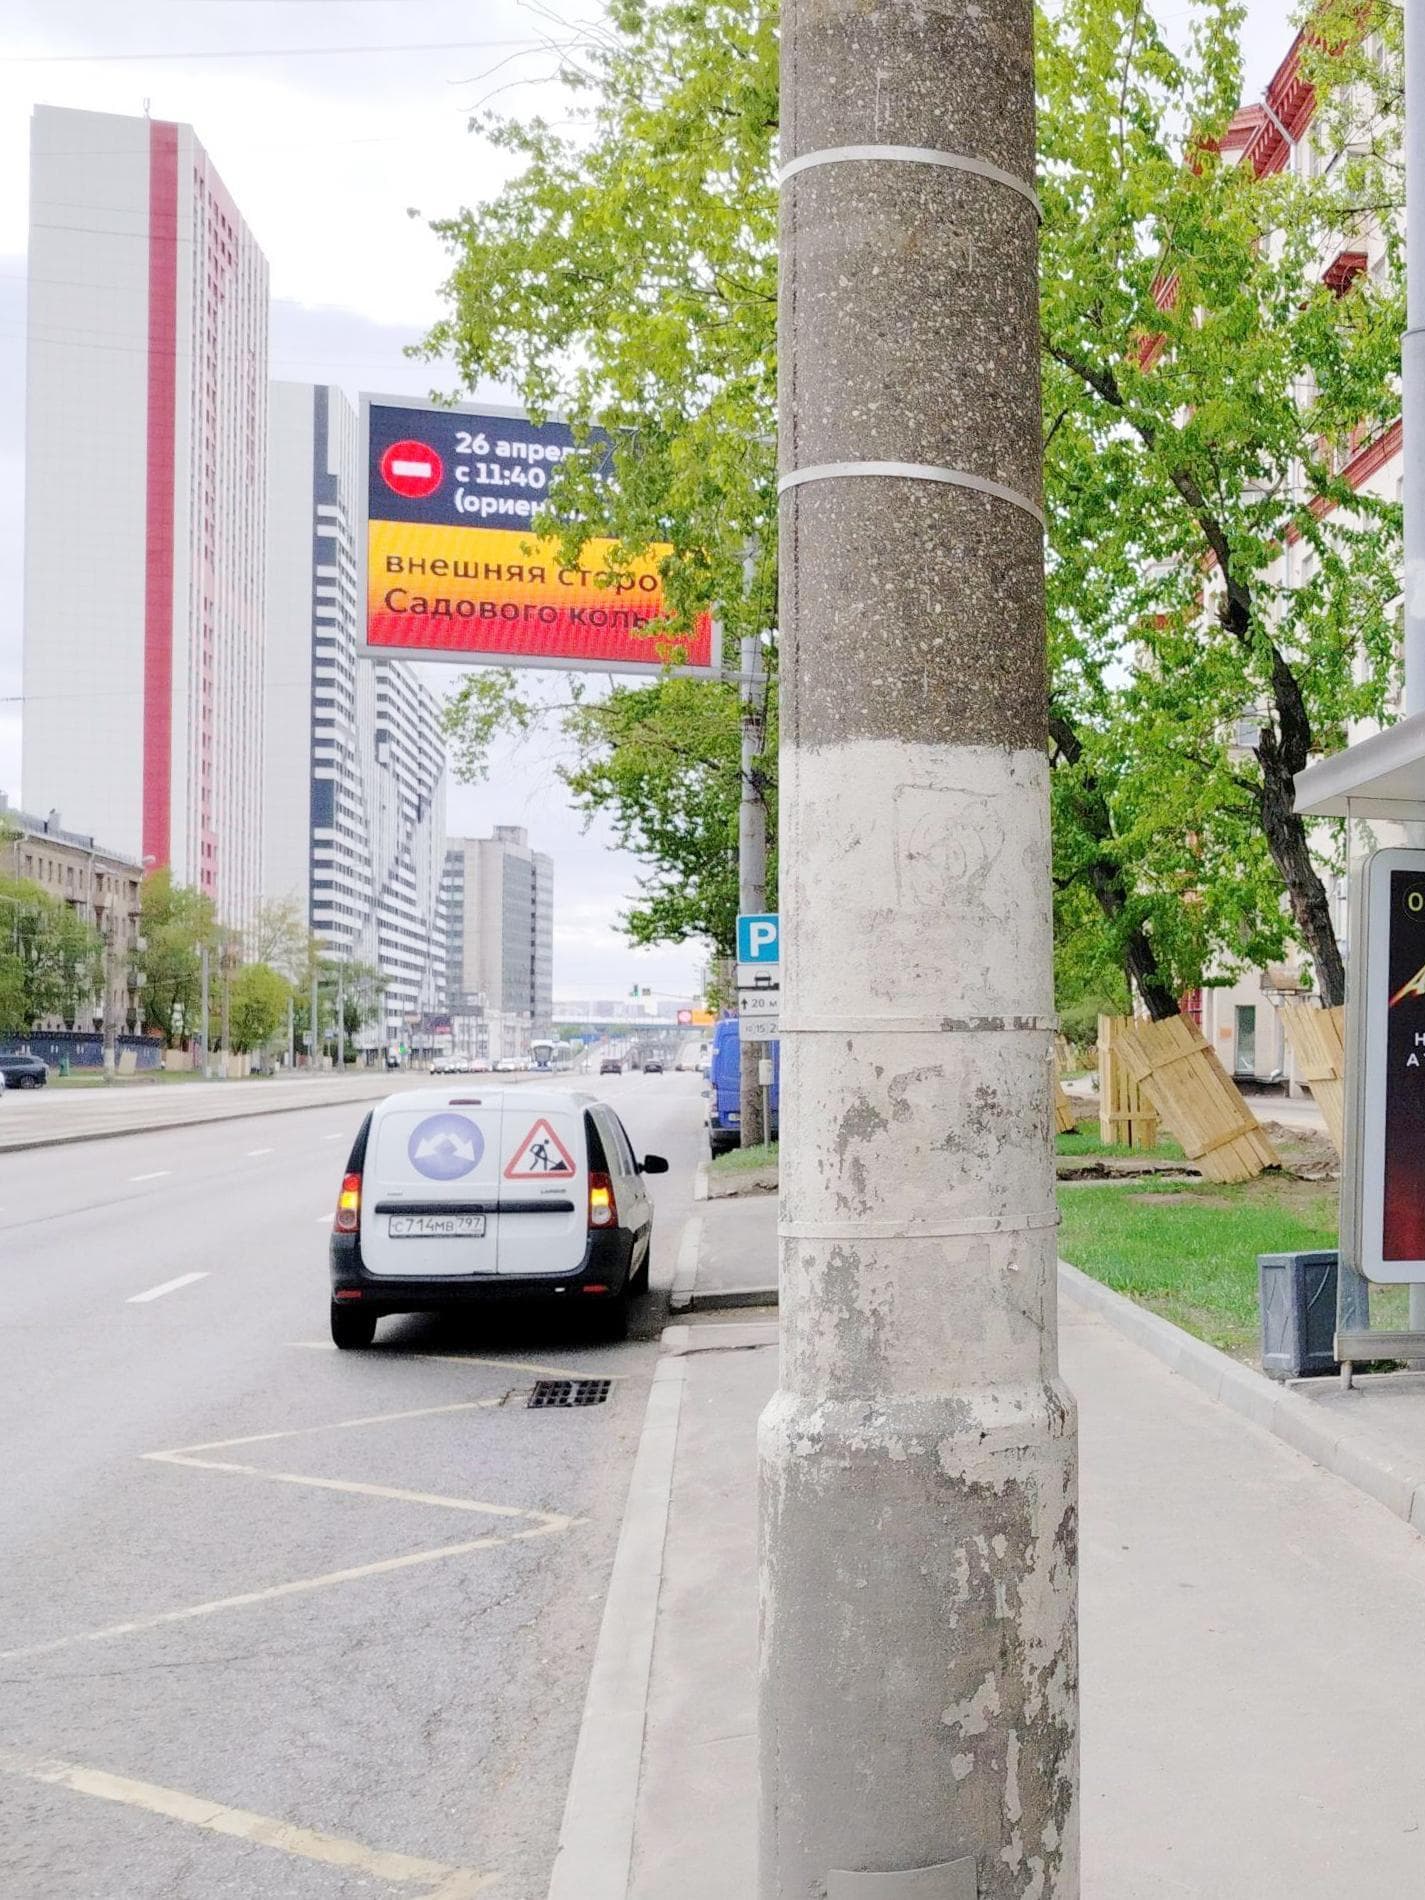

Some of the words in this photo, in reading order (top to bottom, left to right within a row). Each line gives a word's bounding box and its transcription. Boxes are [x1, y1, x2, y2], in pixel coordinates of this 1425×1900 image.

[455, 431, 490, 455] 26
[455, 465, 470, 482] с
[476, 462, 546, 489] 11:40
[386, 555, 546, 584] внешняя
[384, 587, 558, 624] Садового
[570, 606, 650, 630] коль
[750, 921, 777, 957] P
[752, 999, 765, 1008] 20
[1406, 1053, 1419, 1067] А
